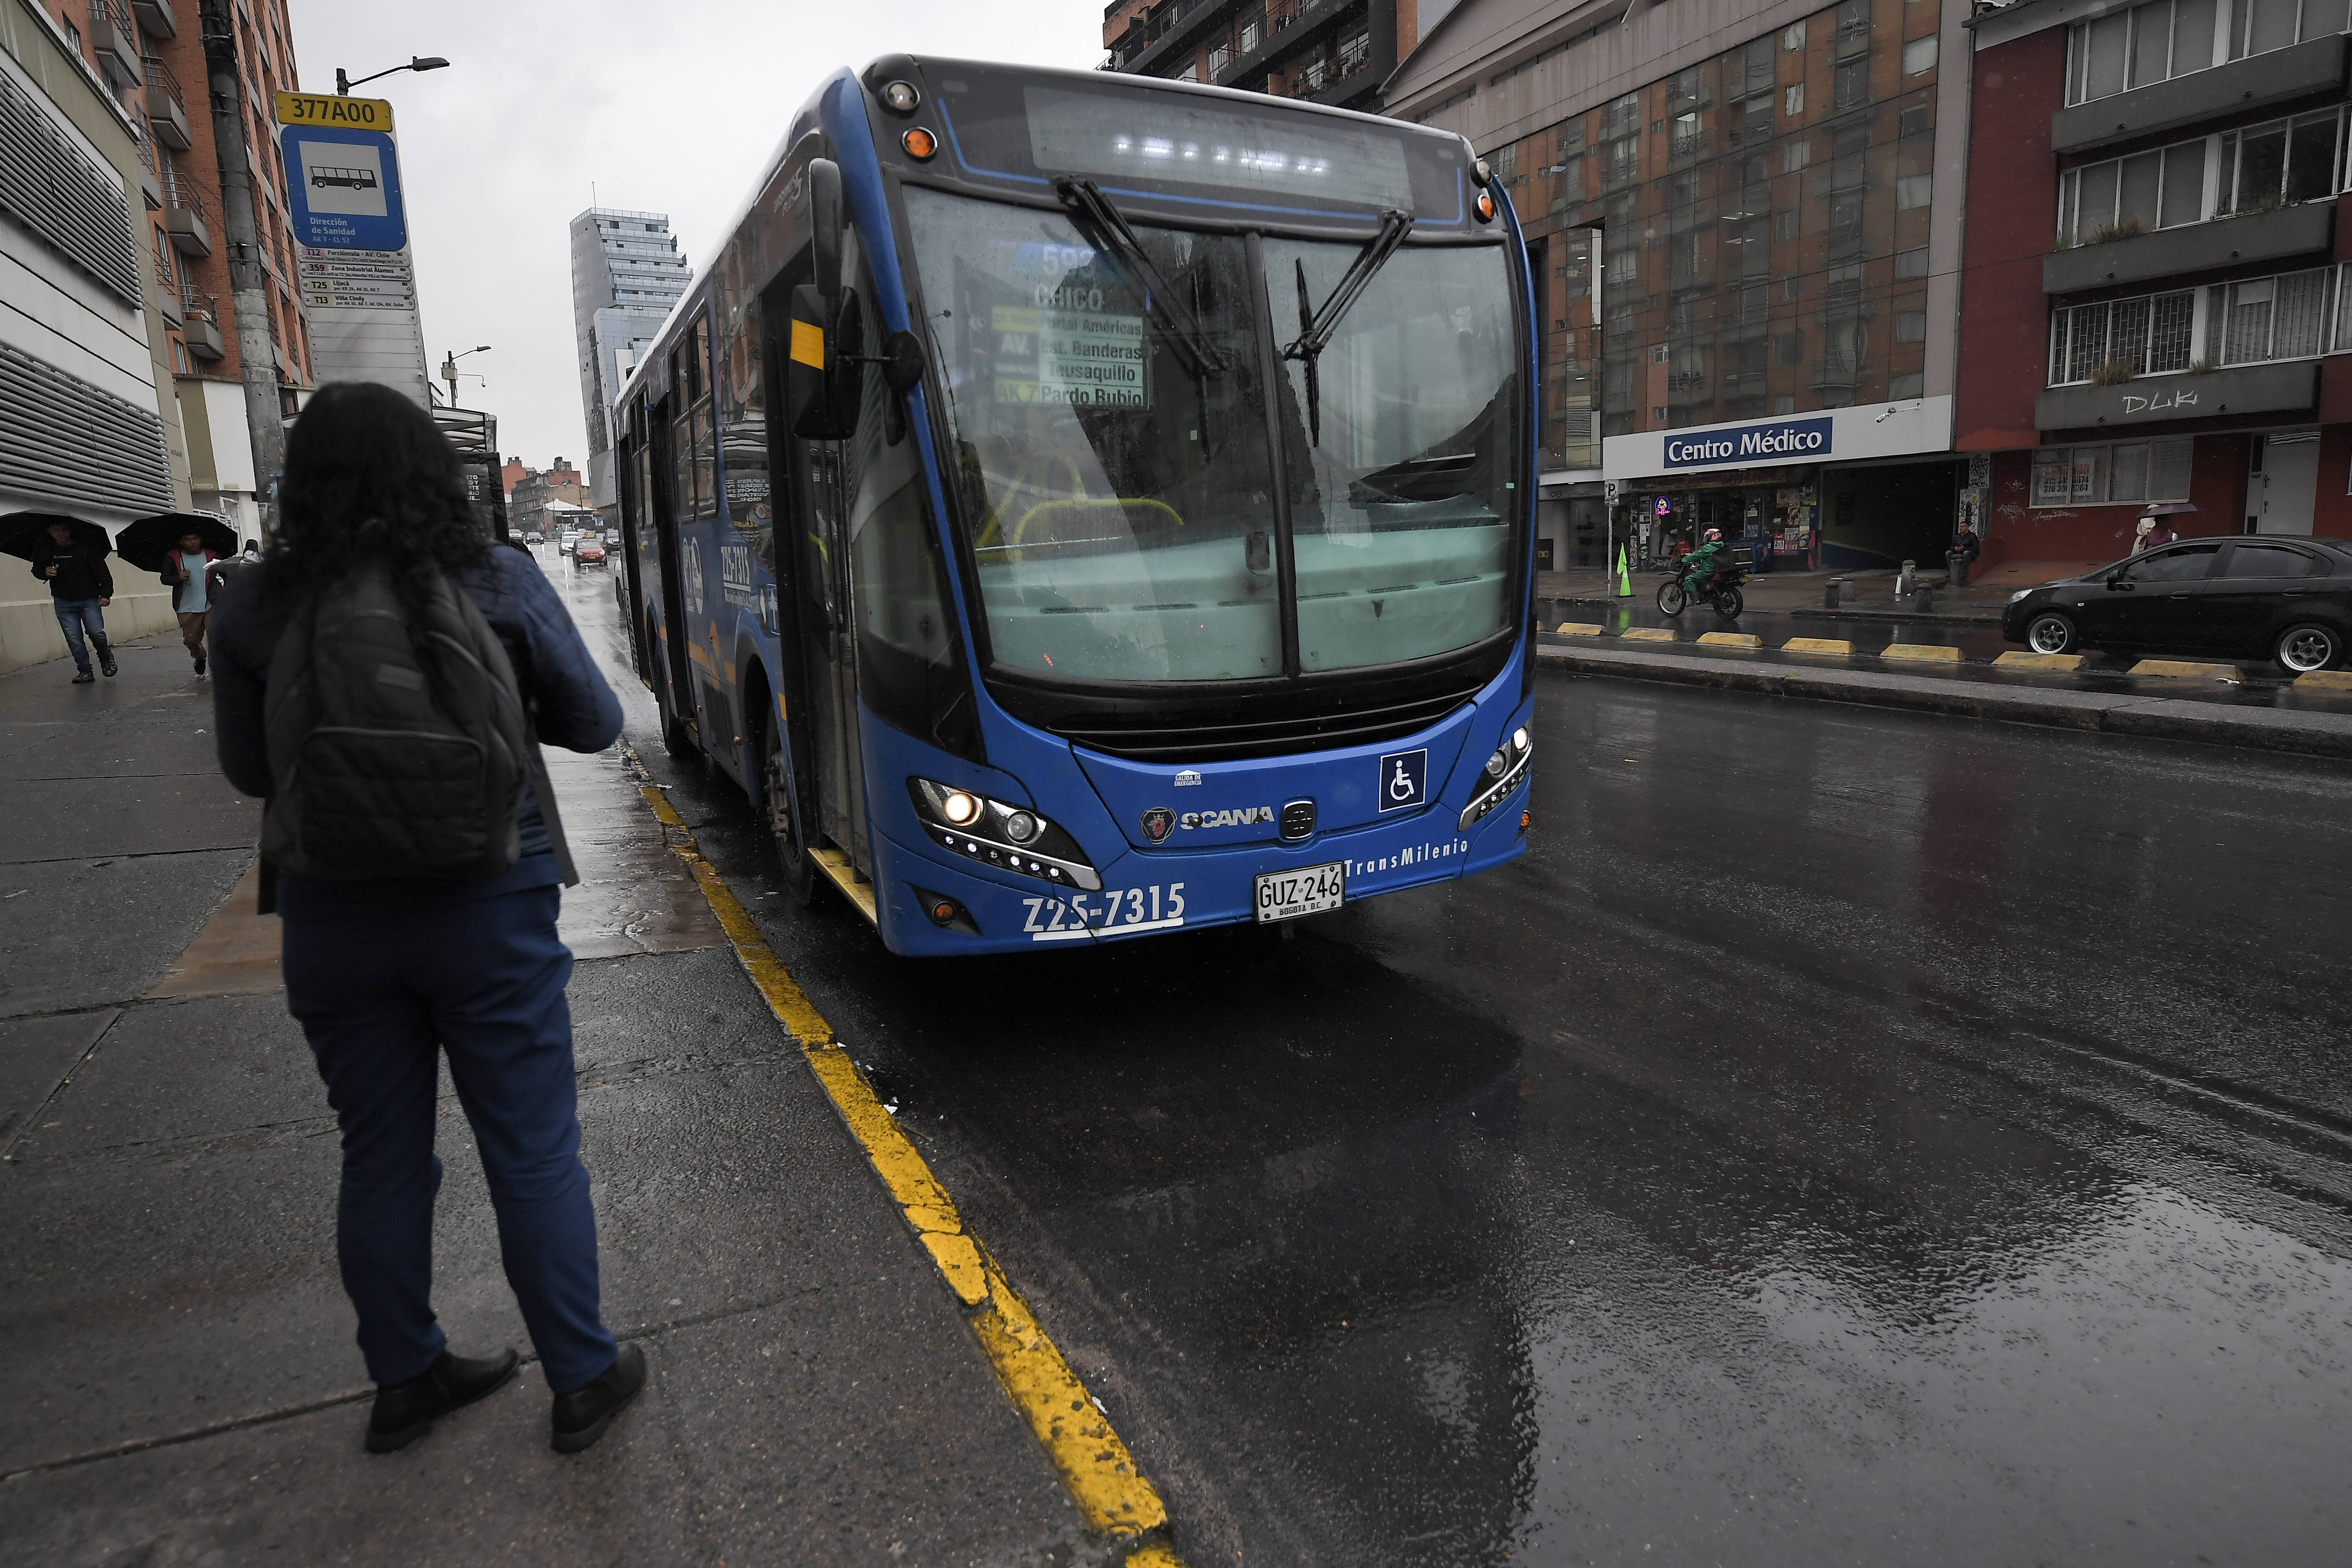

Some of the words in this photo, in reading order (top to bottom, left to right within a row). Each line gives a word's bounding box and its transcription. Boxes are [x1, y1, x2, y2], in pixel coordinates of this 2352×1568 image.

[291, 98, 375, 123] 377A00
[310, 217, 347, 226] Dirección
[1082, 318, 1142, 336] Américas
[1001, 333, 1030, 355] AV.
[1072, 341, 1142, 360] Banderas
[1049, 361, 1135, 382] Teusaquillo
[1041, 385, 1089, 404] Pardo
[1095, 388, 1142, 406] Rubio
[1668, 439, 1734, 462] Centro
[1739, 429, 1822, 455] Médico
[1608, 483, 1616, 496] P
[1180, 806, 1275, 829] SCANIA
[1344, 838, 1468, 878] TransMilenio
[1022, 882, 1185, 932] Z25-7315
[1279, 903, 1306, 916] BOGOTA
[1310, 901, 1323, 910] D.C.
